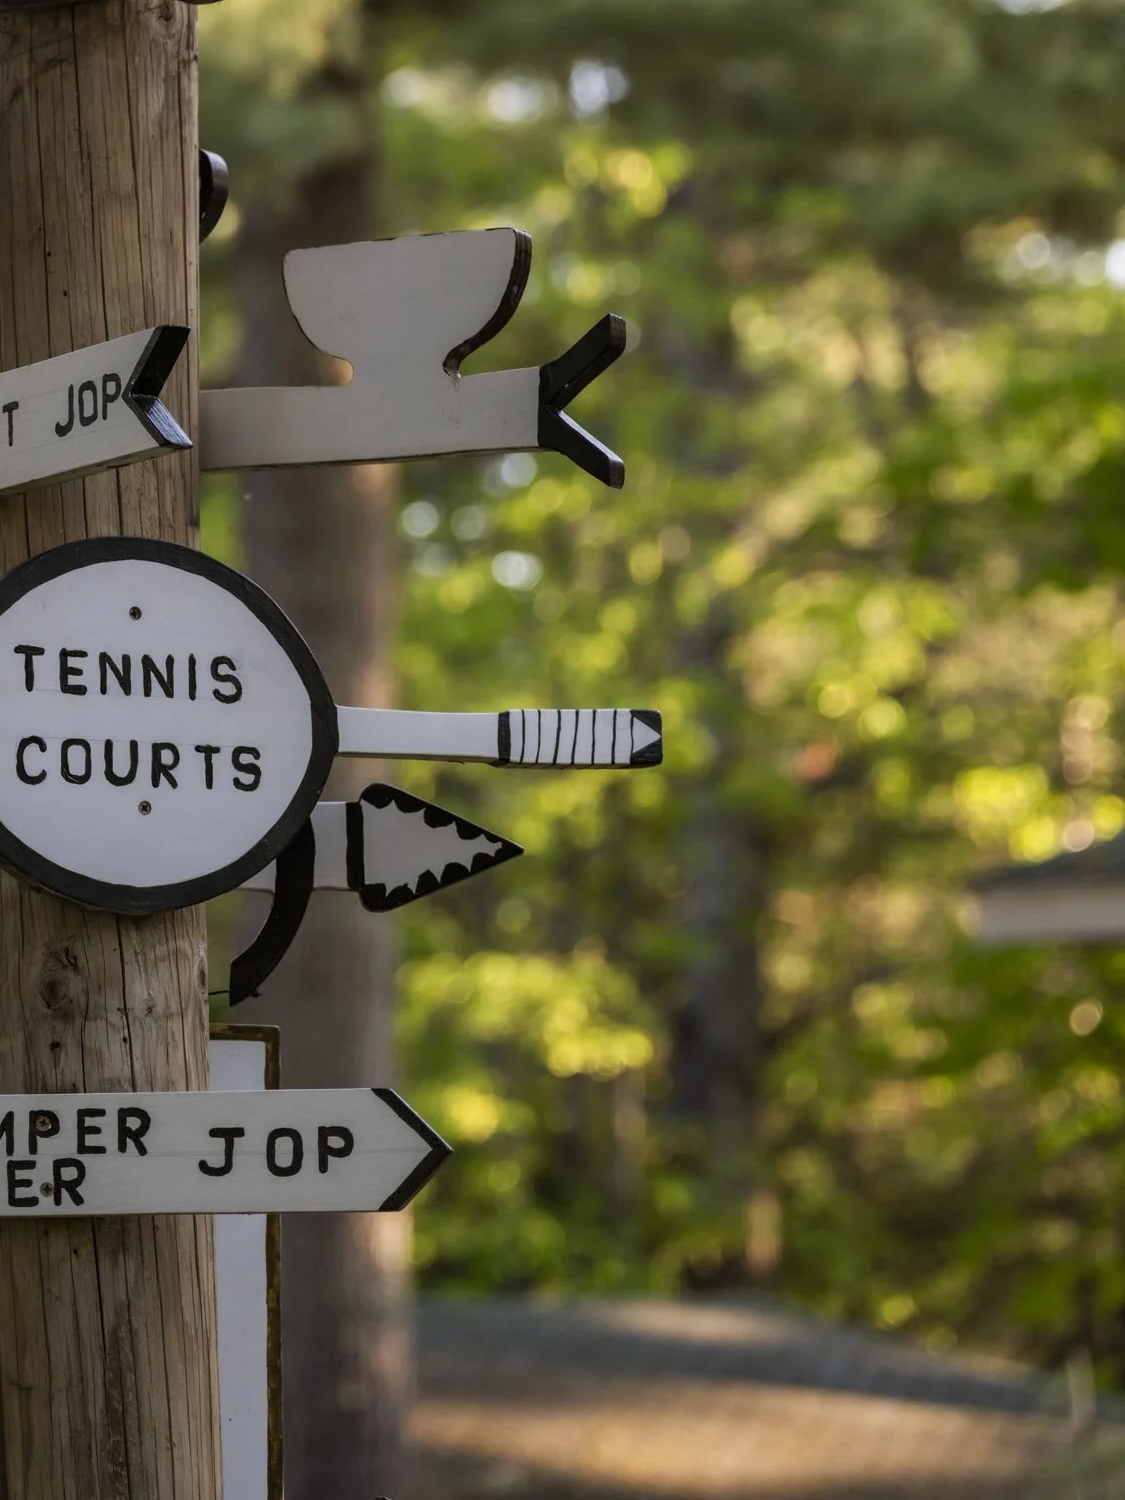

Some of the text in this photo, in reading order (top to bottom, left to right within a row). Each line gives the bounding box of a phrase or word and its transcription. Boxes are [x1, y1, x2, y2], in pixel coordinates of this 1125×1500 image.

[55, 372, 121, 437] JOP
[14, 644, 243, 704] TENNIS
[16, 735, 262, 792] COURTS
[198, 1125, 355, 1177] JOP
